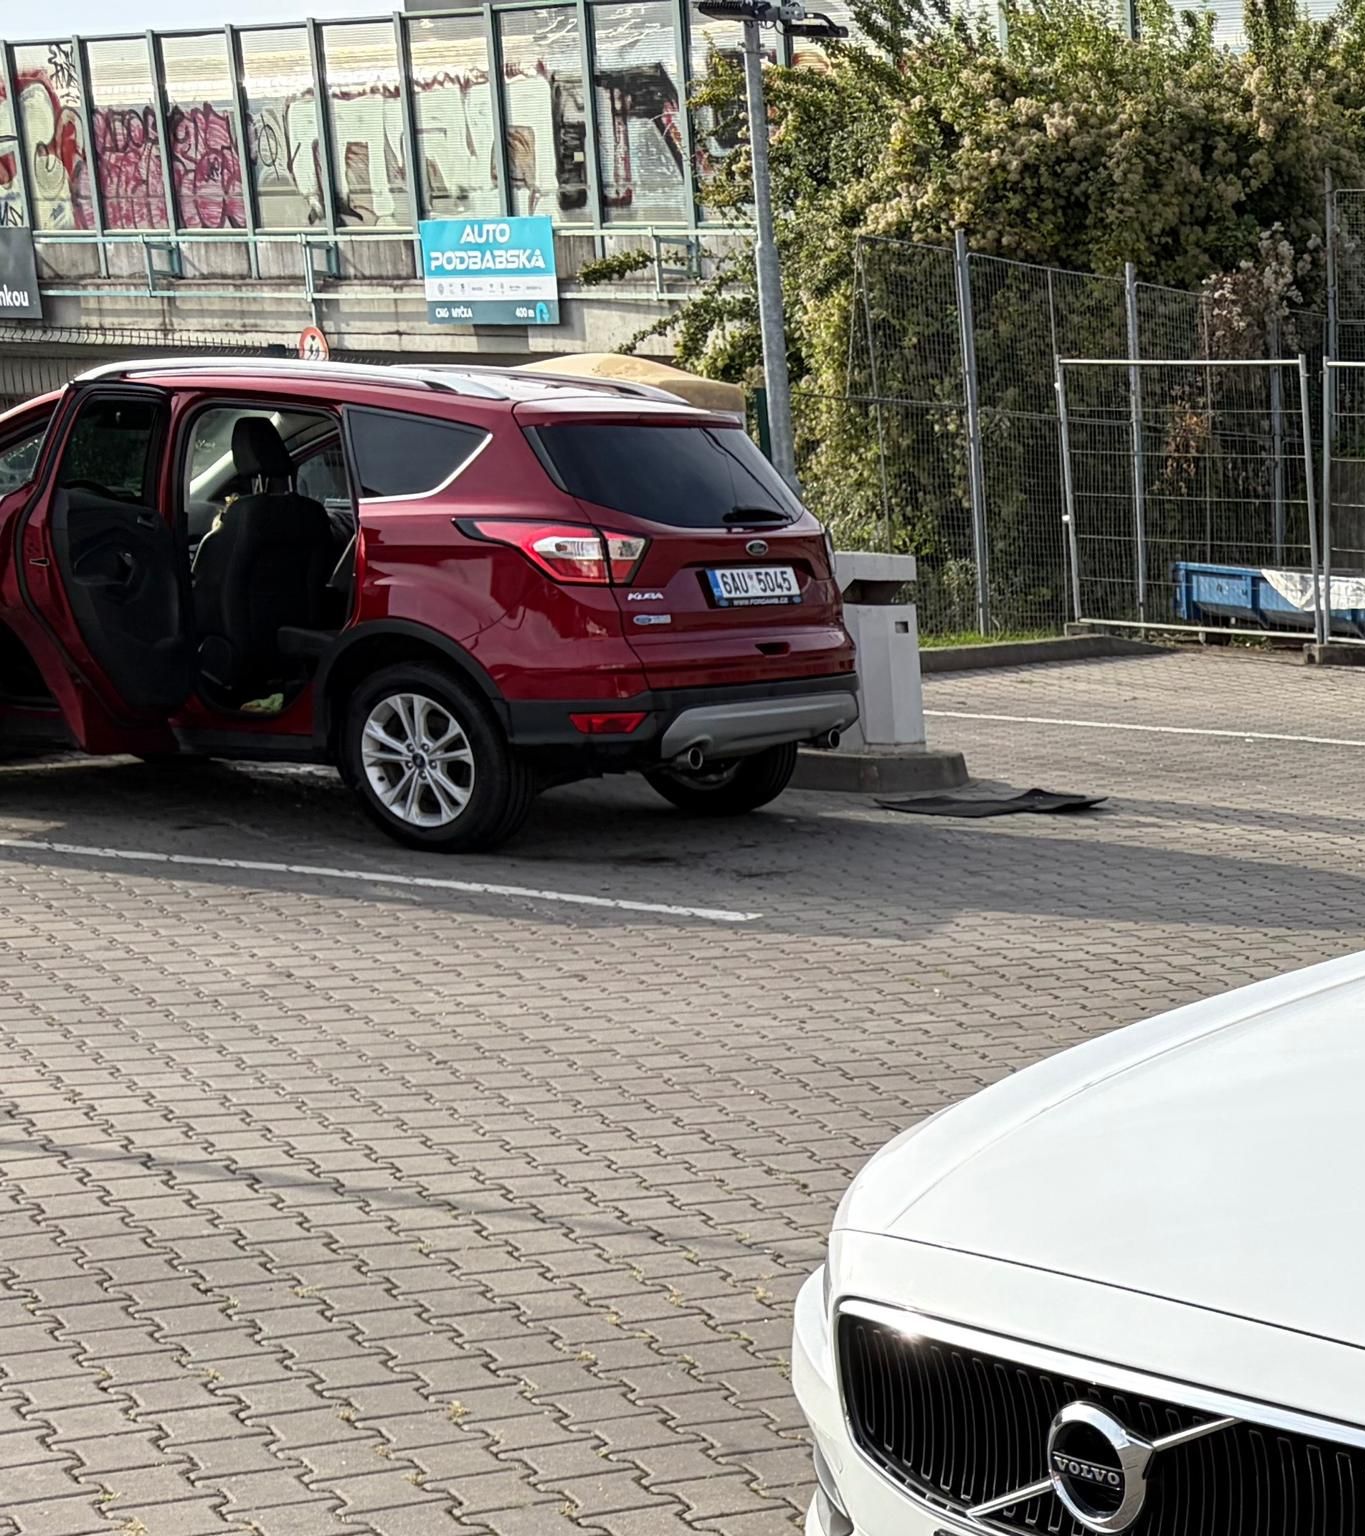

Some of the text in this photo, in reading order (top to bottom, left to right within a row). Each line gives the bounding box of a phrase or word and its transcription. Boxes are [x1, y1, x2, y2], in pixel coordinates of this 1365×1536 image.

[460, 223, 511, 244] AUTO
[430, 248, 546, 271] PODBABSKA
[720, 570, 792, 595] 6AU 5045
[1053, 1455, 1121, 1486] VOLVO
